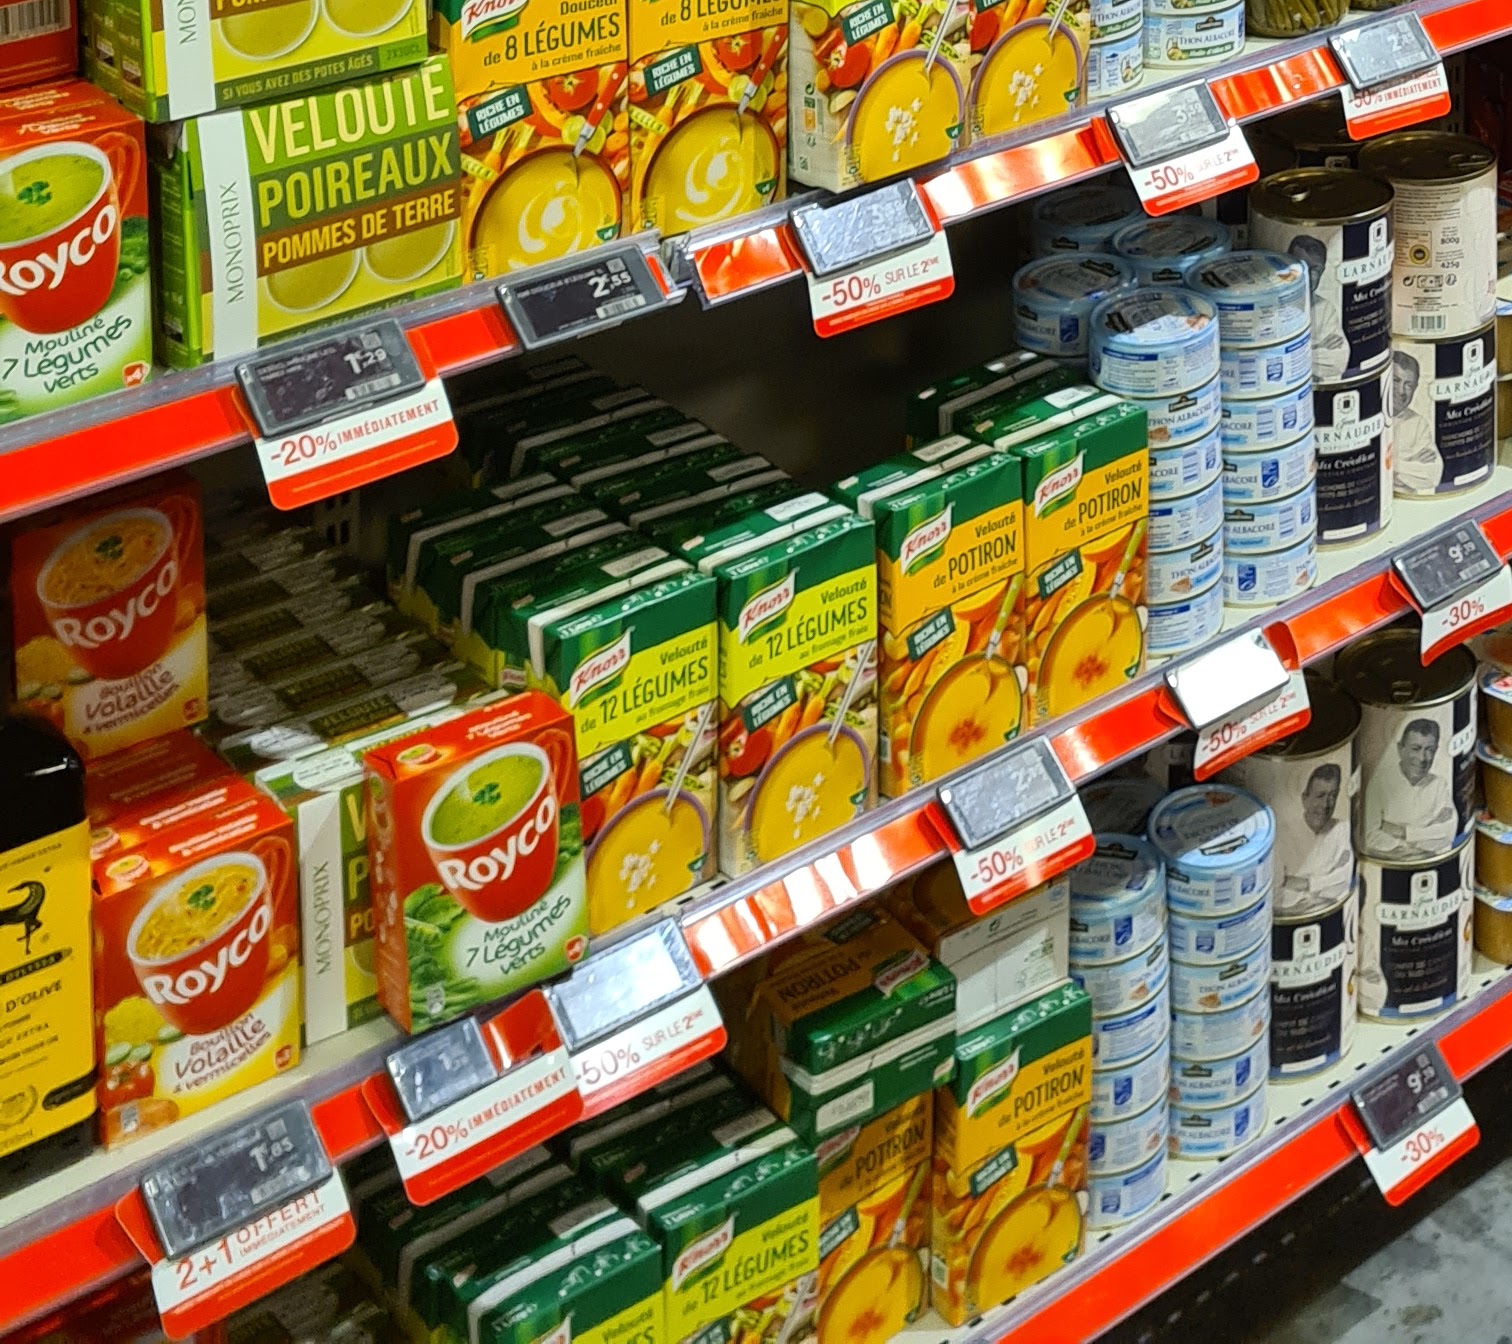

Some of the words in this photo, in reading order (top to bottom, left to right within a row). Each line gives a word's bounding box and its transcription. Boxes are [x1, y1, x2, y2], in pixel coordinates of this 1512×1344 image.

[258, 132, 453, 227] POIREAUX
[220, 179, 245, 304] MONOPRIX
[262, 219, 357, 269] POMMES
[361, 210, 386, 238] DE
[391, 193, 455, 230] TERRE
[3, 358, 18, 381] 7
[24, 315, 132, 378] Légumes
[25, 314, 105, 355] Mouliné
[43, 362, 99, 393] verts
[1078, 478, 1143, 522] POTIRON
[1105, 461, 1143, 485] Velouté
[57, 560, 178, 649] Royco
[1442, 598, 1484, 627] -30%
[437, 796, 556, 891] Royco
[466, 946, 479, 967] 7
[482, 893, 571, 975] Légumes
[482, 900, 548, 946] Mouliné
[142, 904, 270, 1005] Royco
[500, 939, 548, 976] verts
[574, 1043, 640, 1086] -50%
